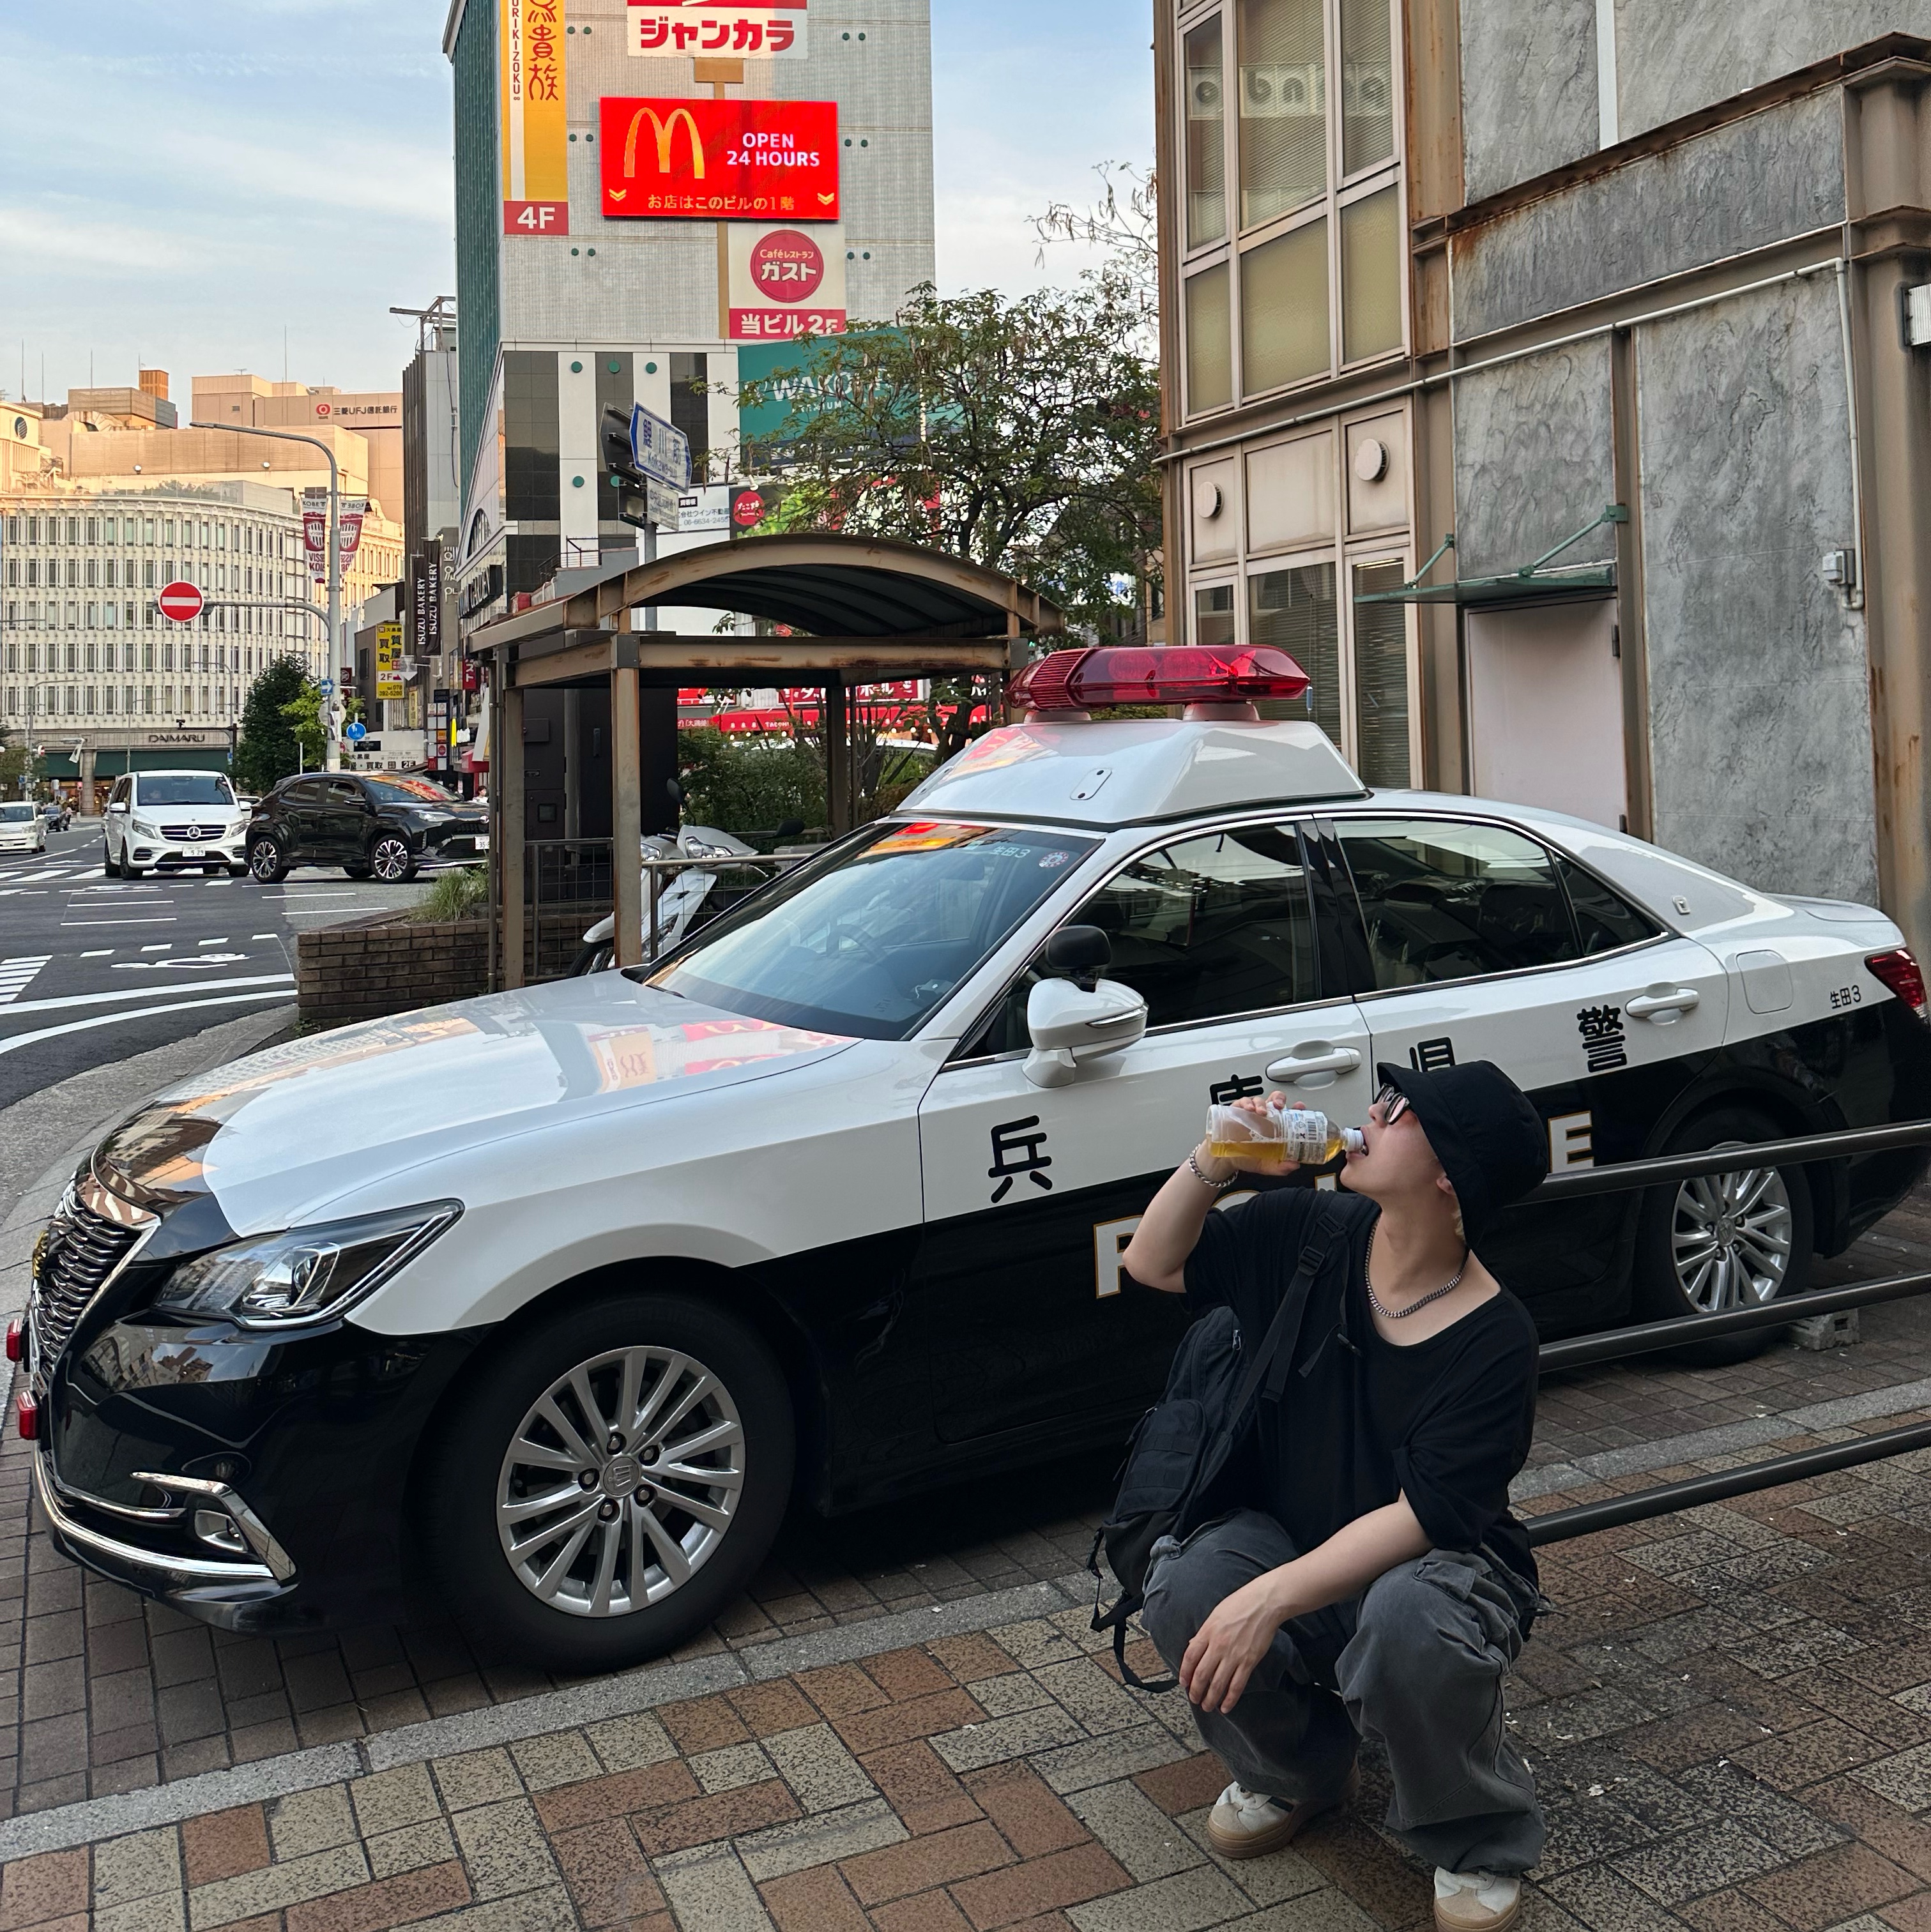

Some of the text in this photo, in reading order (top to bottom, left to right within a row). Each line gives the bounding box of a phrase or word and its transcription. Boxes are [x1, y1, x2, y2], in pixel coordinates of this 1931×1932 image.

[640, 16, 795, 52] ジャンカラ
[742, 132, 794, 148] OPEN
[726, 150, 820, 167] 24 HOURS
[648, 194, 795, 211] お店はこのビルの1階
[517, 206, 556, 229] 4F
[761, 261, 817, 282] ガスト
[429, 562, 438, 635] ISUZU BAKERY
[417, 577, 426, 645] ISUZU BAKERY
[380, 673, 393, 681] 2F
[148, 734, 205, 743] DAIMARU
[1829, 984, 1861, 1010] 生田3
[988, 1114, 1053, 1203] 兵
